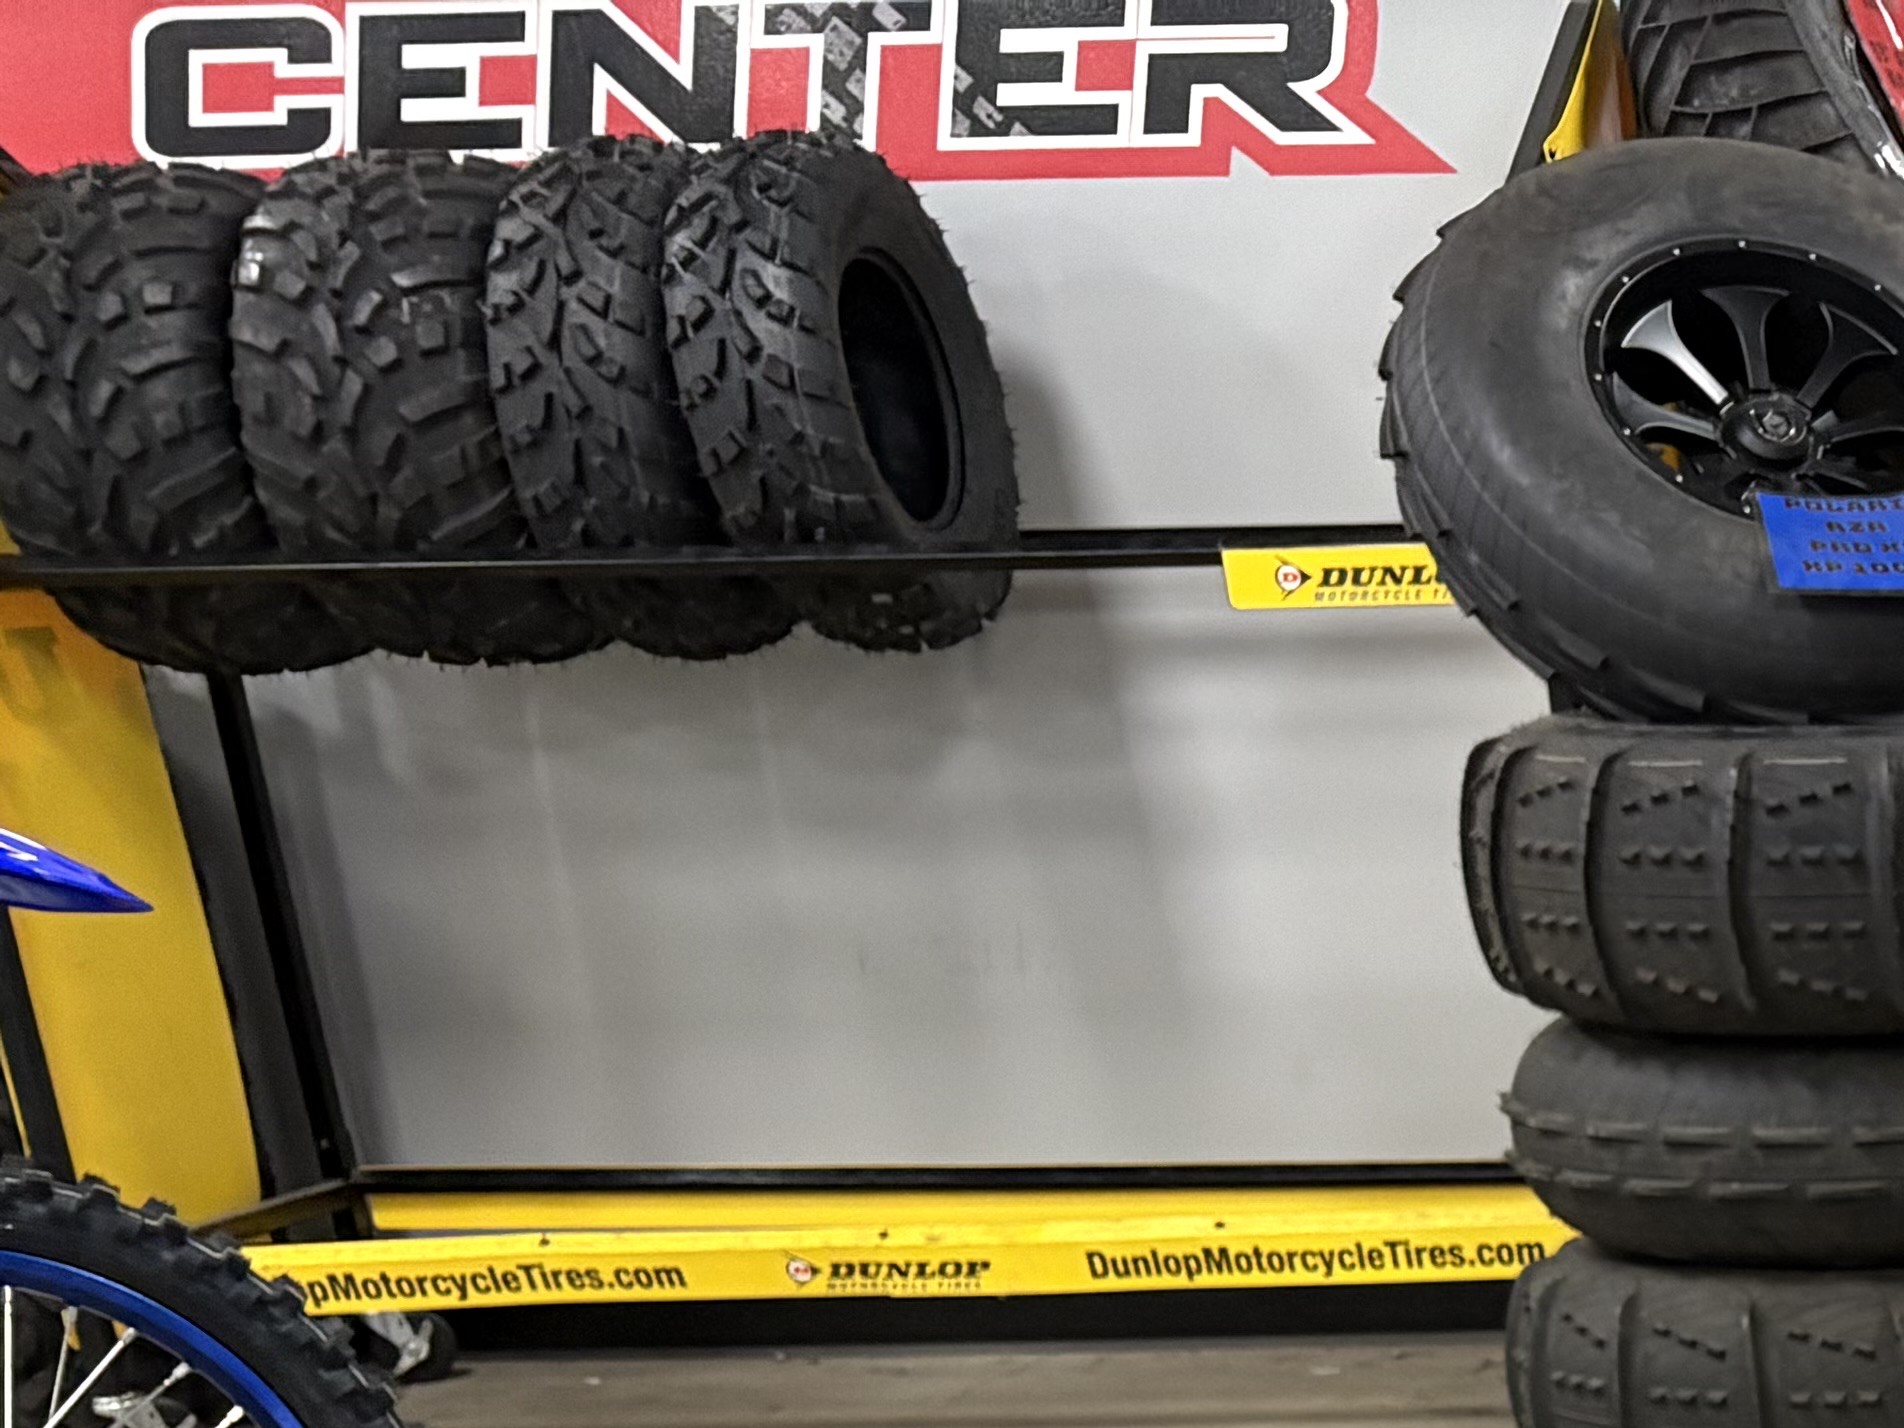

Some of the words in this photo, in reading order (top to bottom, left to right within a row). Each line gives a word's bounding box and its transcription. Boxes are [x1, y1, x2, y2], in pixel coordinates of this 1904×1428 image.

[135, 0, 1372, 168] CENTER
[1316, 564, 1436, 588] DUNL
[829, 1260, 991, 1280] DUNLOP
[1085, 1239, 1547, 1282] DunlopMotorcycleTires.com
[303, 1261, 688, 1308] pMotorcycleTires.com
